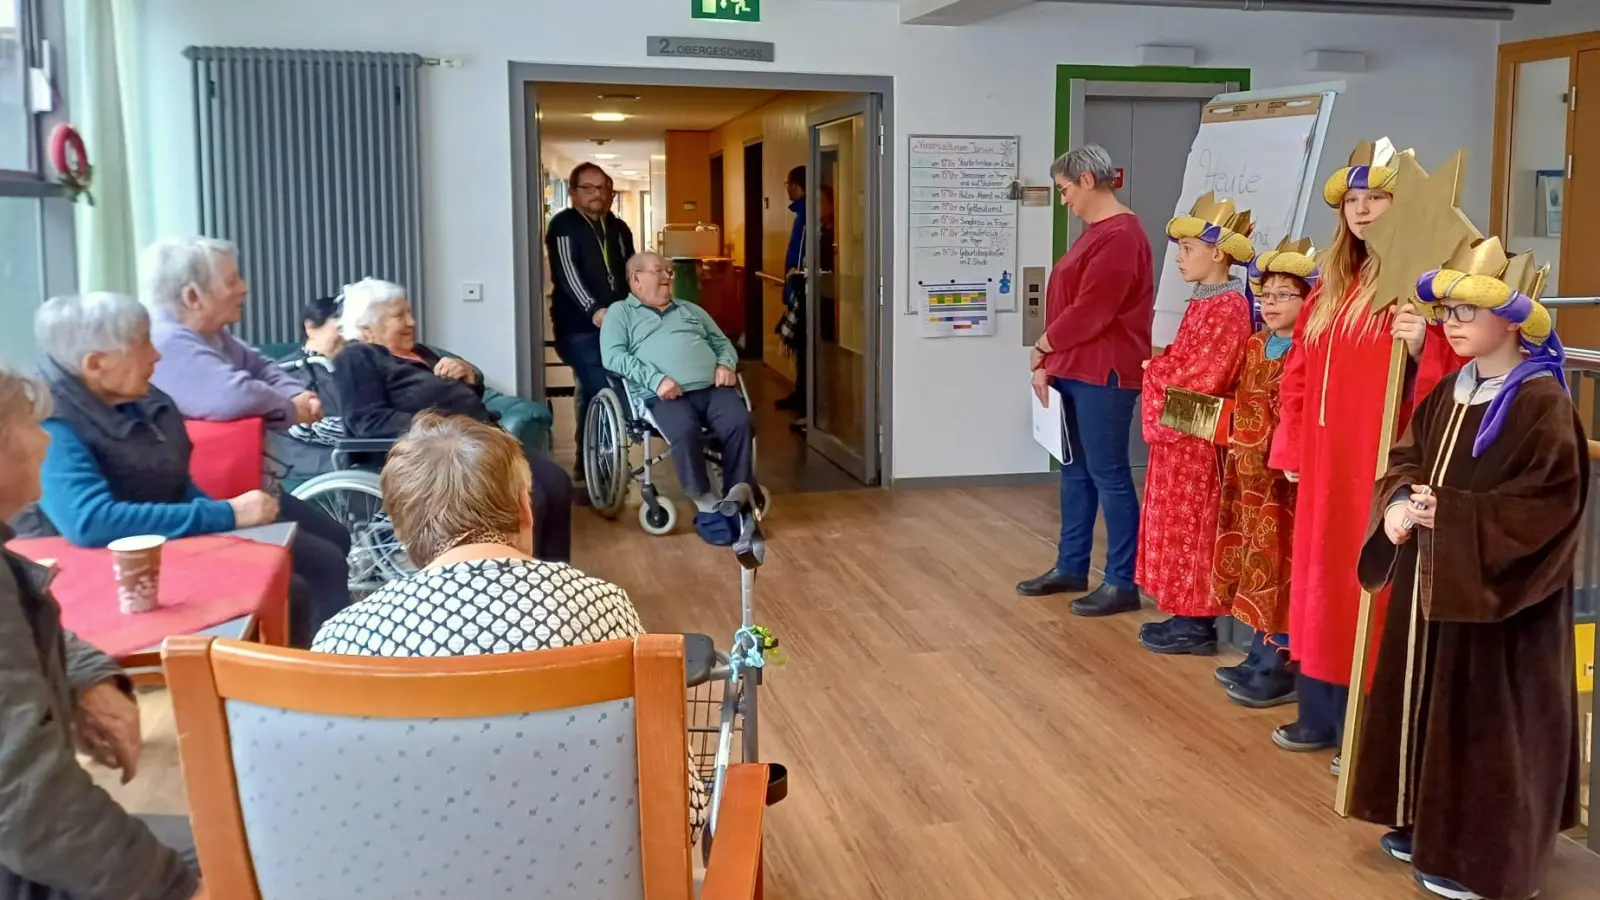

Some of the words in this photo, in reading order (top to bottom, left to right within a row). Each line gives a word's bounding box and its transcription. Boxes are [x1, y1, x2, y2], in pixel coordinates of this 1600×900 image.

[659, 38, 675, 54] 2.
[676, 45, 763, 58] OBERGESCHOSS
[1200, 149, 1261, 195] Heute
